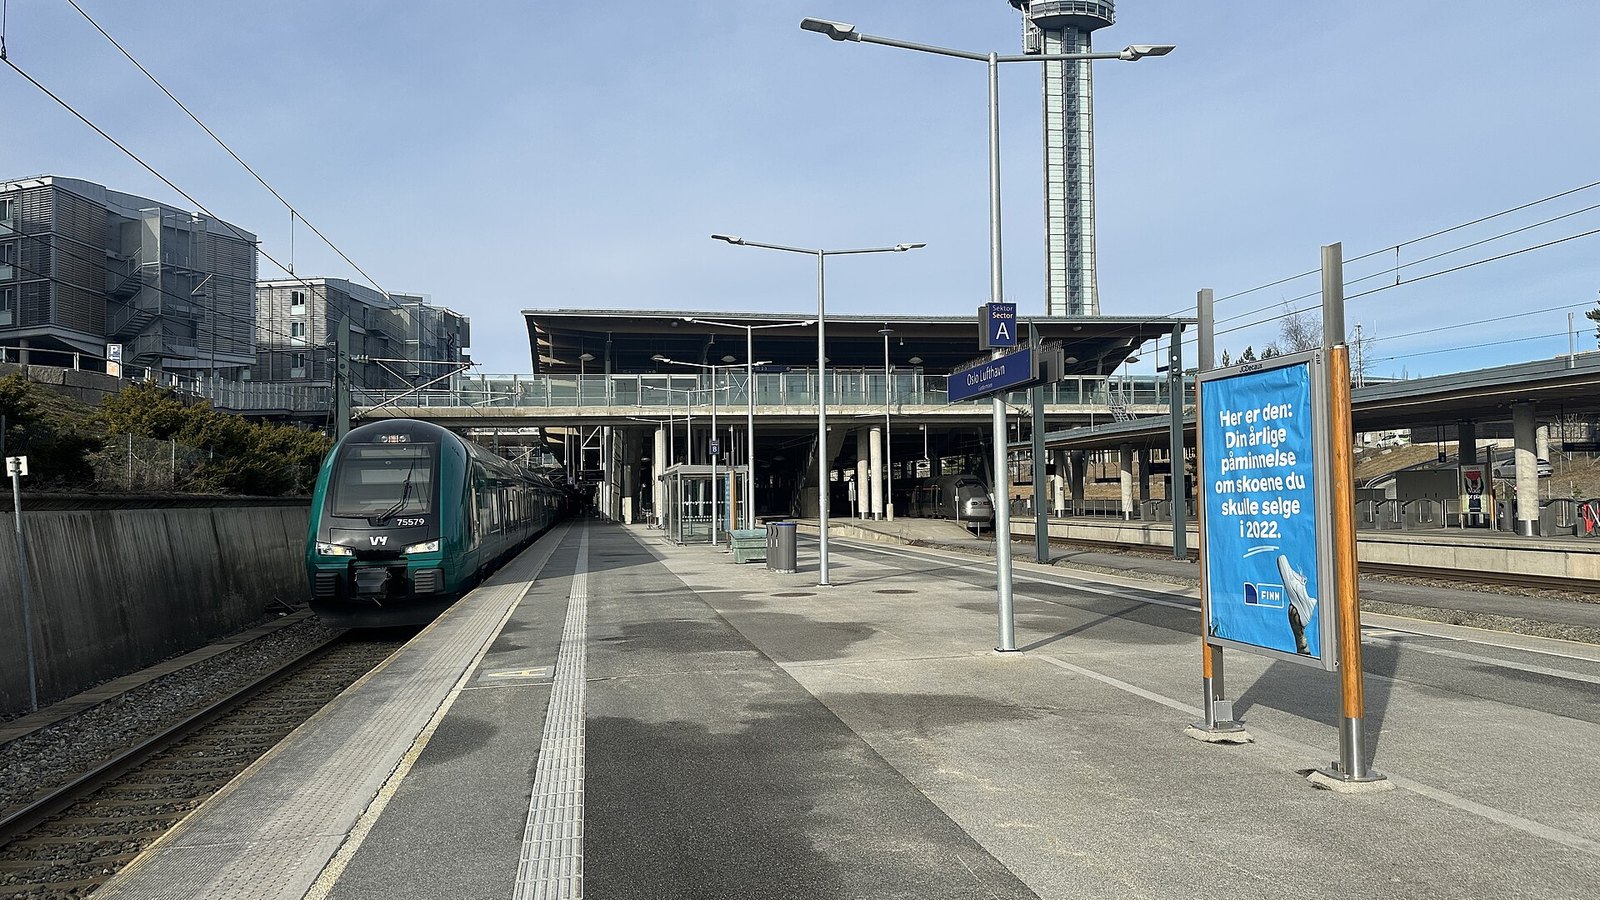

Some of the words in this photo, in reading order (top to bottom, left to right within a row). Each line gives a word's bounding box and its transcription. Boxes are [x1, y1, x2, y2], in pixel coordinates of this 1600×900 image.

[992, 304, 1013, 312] Sektor
[996, 322, 1010, 340] A
[110, 345, 118, 355] P
[966, 371, 979, 386] Oslo
[979, 364, 1006, 382] Lufthavn
[1219, 409, 1243, 427] Her
[1245, 408, 1260, 424] er
[1262, 402, 1293, 421] den:
[1225, 430, 1247, 449] Din
[1248, 425, 1287, 448] årlige
[1221, 448, 1297, 475] påminnelse
[1215, 480, 1235, 494] om
[1236, 475, 1284, 493] skoene
[1285, 471, 1306, 490] du
[1221, 498, 1259, 516] skulle
[1261, 496, 1300, 519] selge
[396, 518, 425, 526] 75579
[1239, 519, 1245, 538] i
[1246, 520, 1282, 539] 2022.
[1261, 590, 1280, 601] FINN
